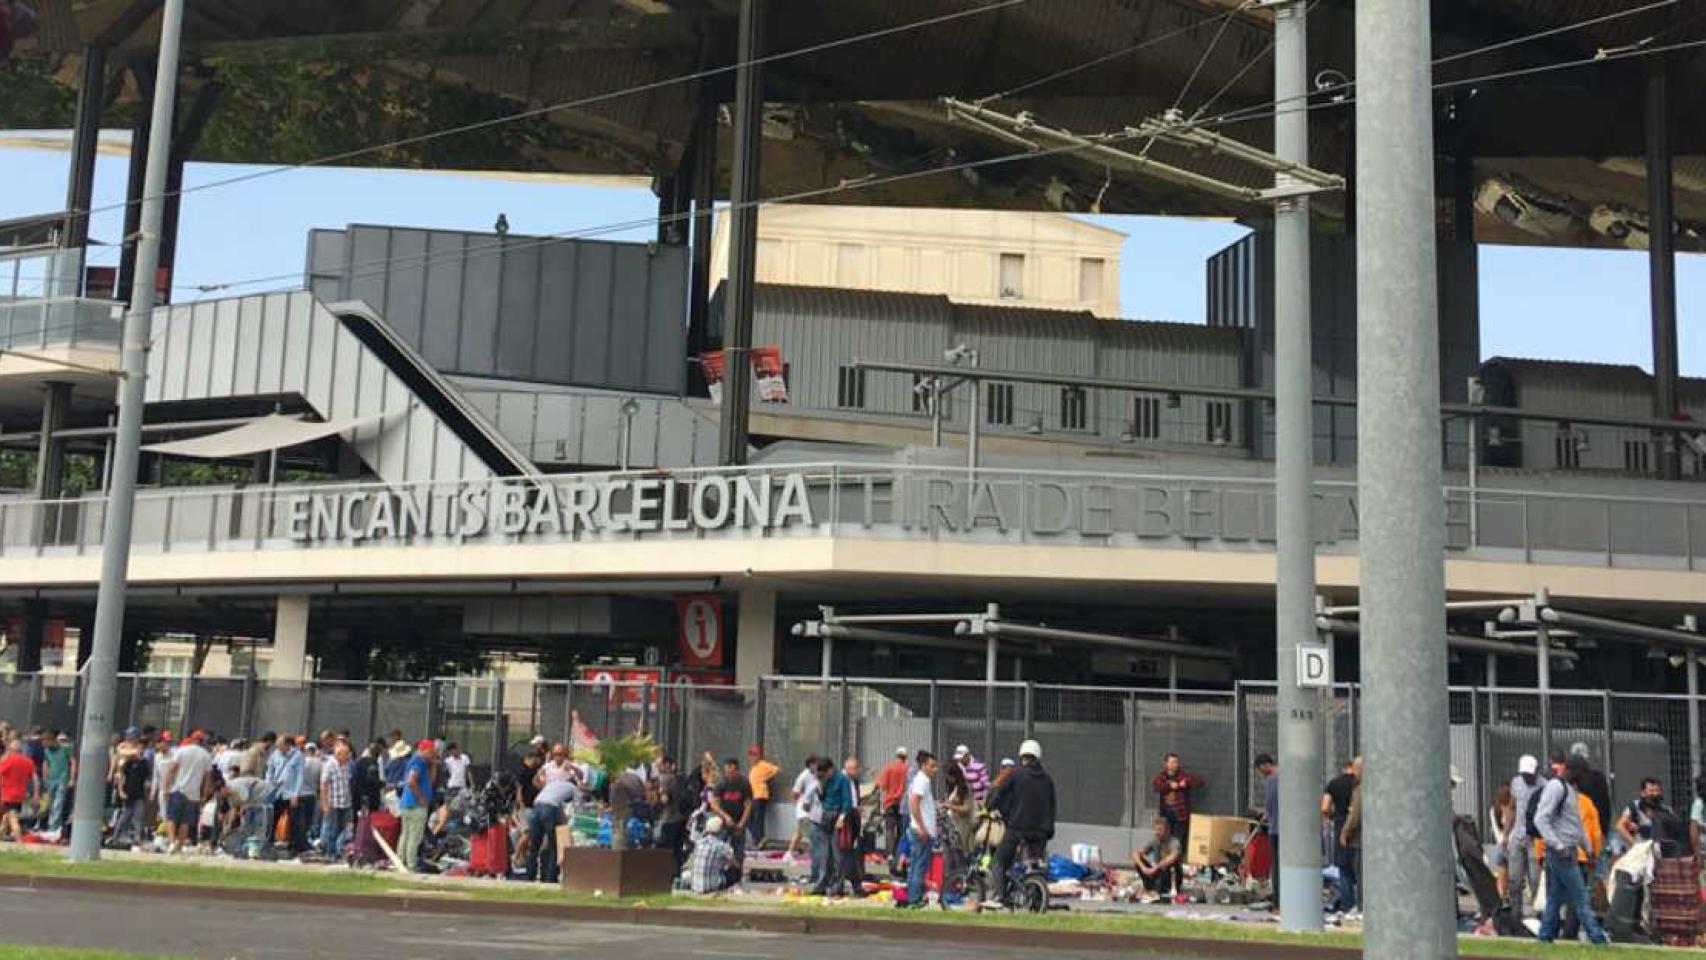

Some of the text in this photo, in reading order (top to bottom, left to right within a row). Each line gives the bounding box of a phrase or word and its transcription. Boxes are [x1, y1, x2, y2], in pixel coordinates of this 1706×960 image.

[288, 472, 815, 540] ENCANTS BARCELONA
[863, 475, 1008, 534] FIRA
[1031, 482, 1113, 538] DE
[1307, 653, 1324, 679] D
